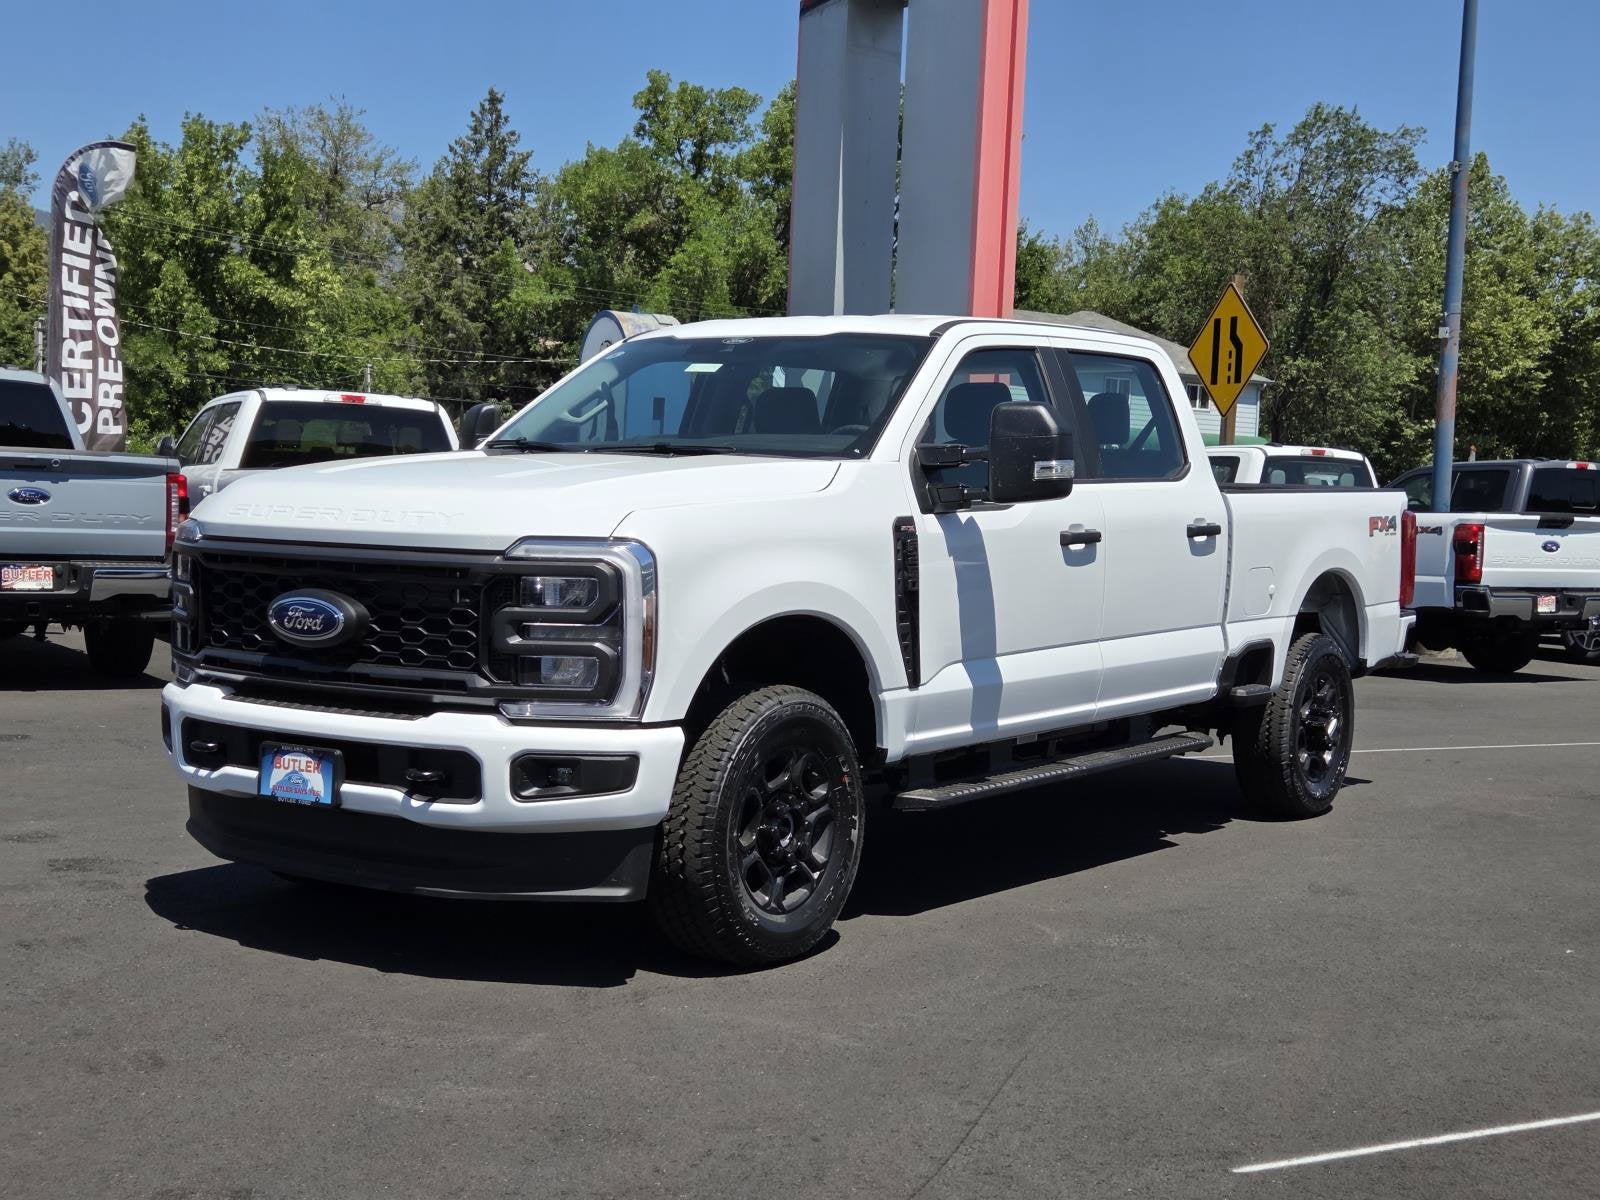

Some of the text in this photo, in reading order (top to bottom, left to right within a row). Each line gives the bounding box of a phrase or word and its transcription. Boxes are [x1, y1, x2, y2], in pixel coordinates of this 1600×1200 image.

[61, 190, 95, 435] CERTIFIED
[51, 512, 153, 525] DUTY
[227, 503, 466, 529] SUPER DUTY
[1369, 516, 1397, 537] FX4
[2, 569, 52, 580] BUTLER
[284, 606, 325, 631] Ford
[274, 756, 321, 774] BUTLER
